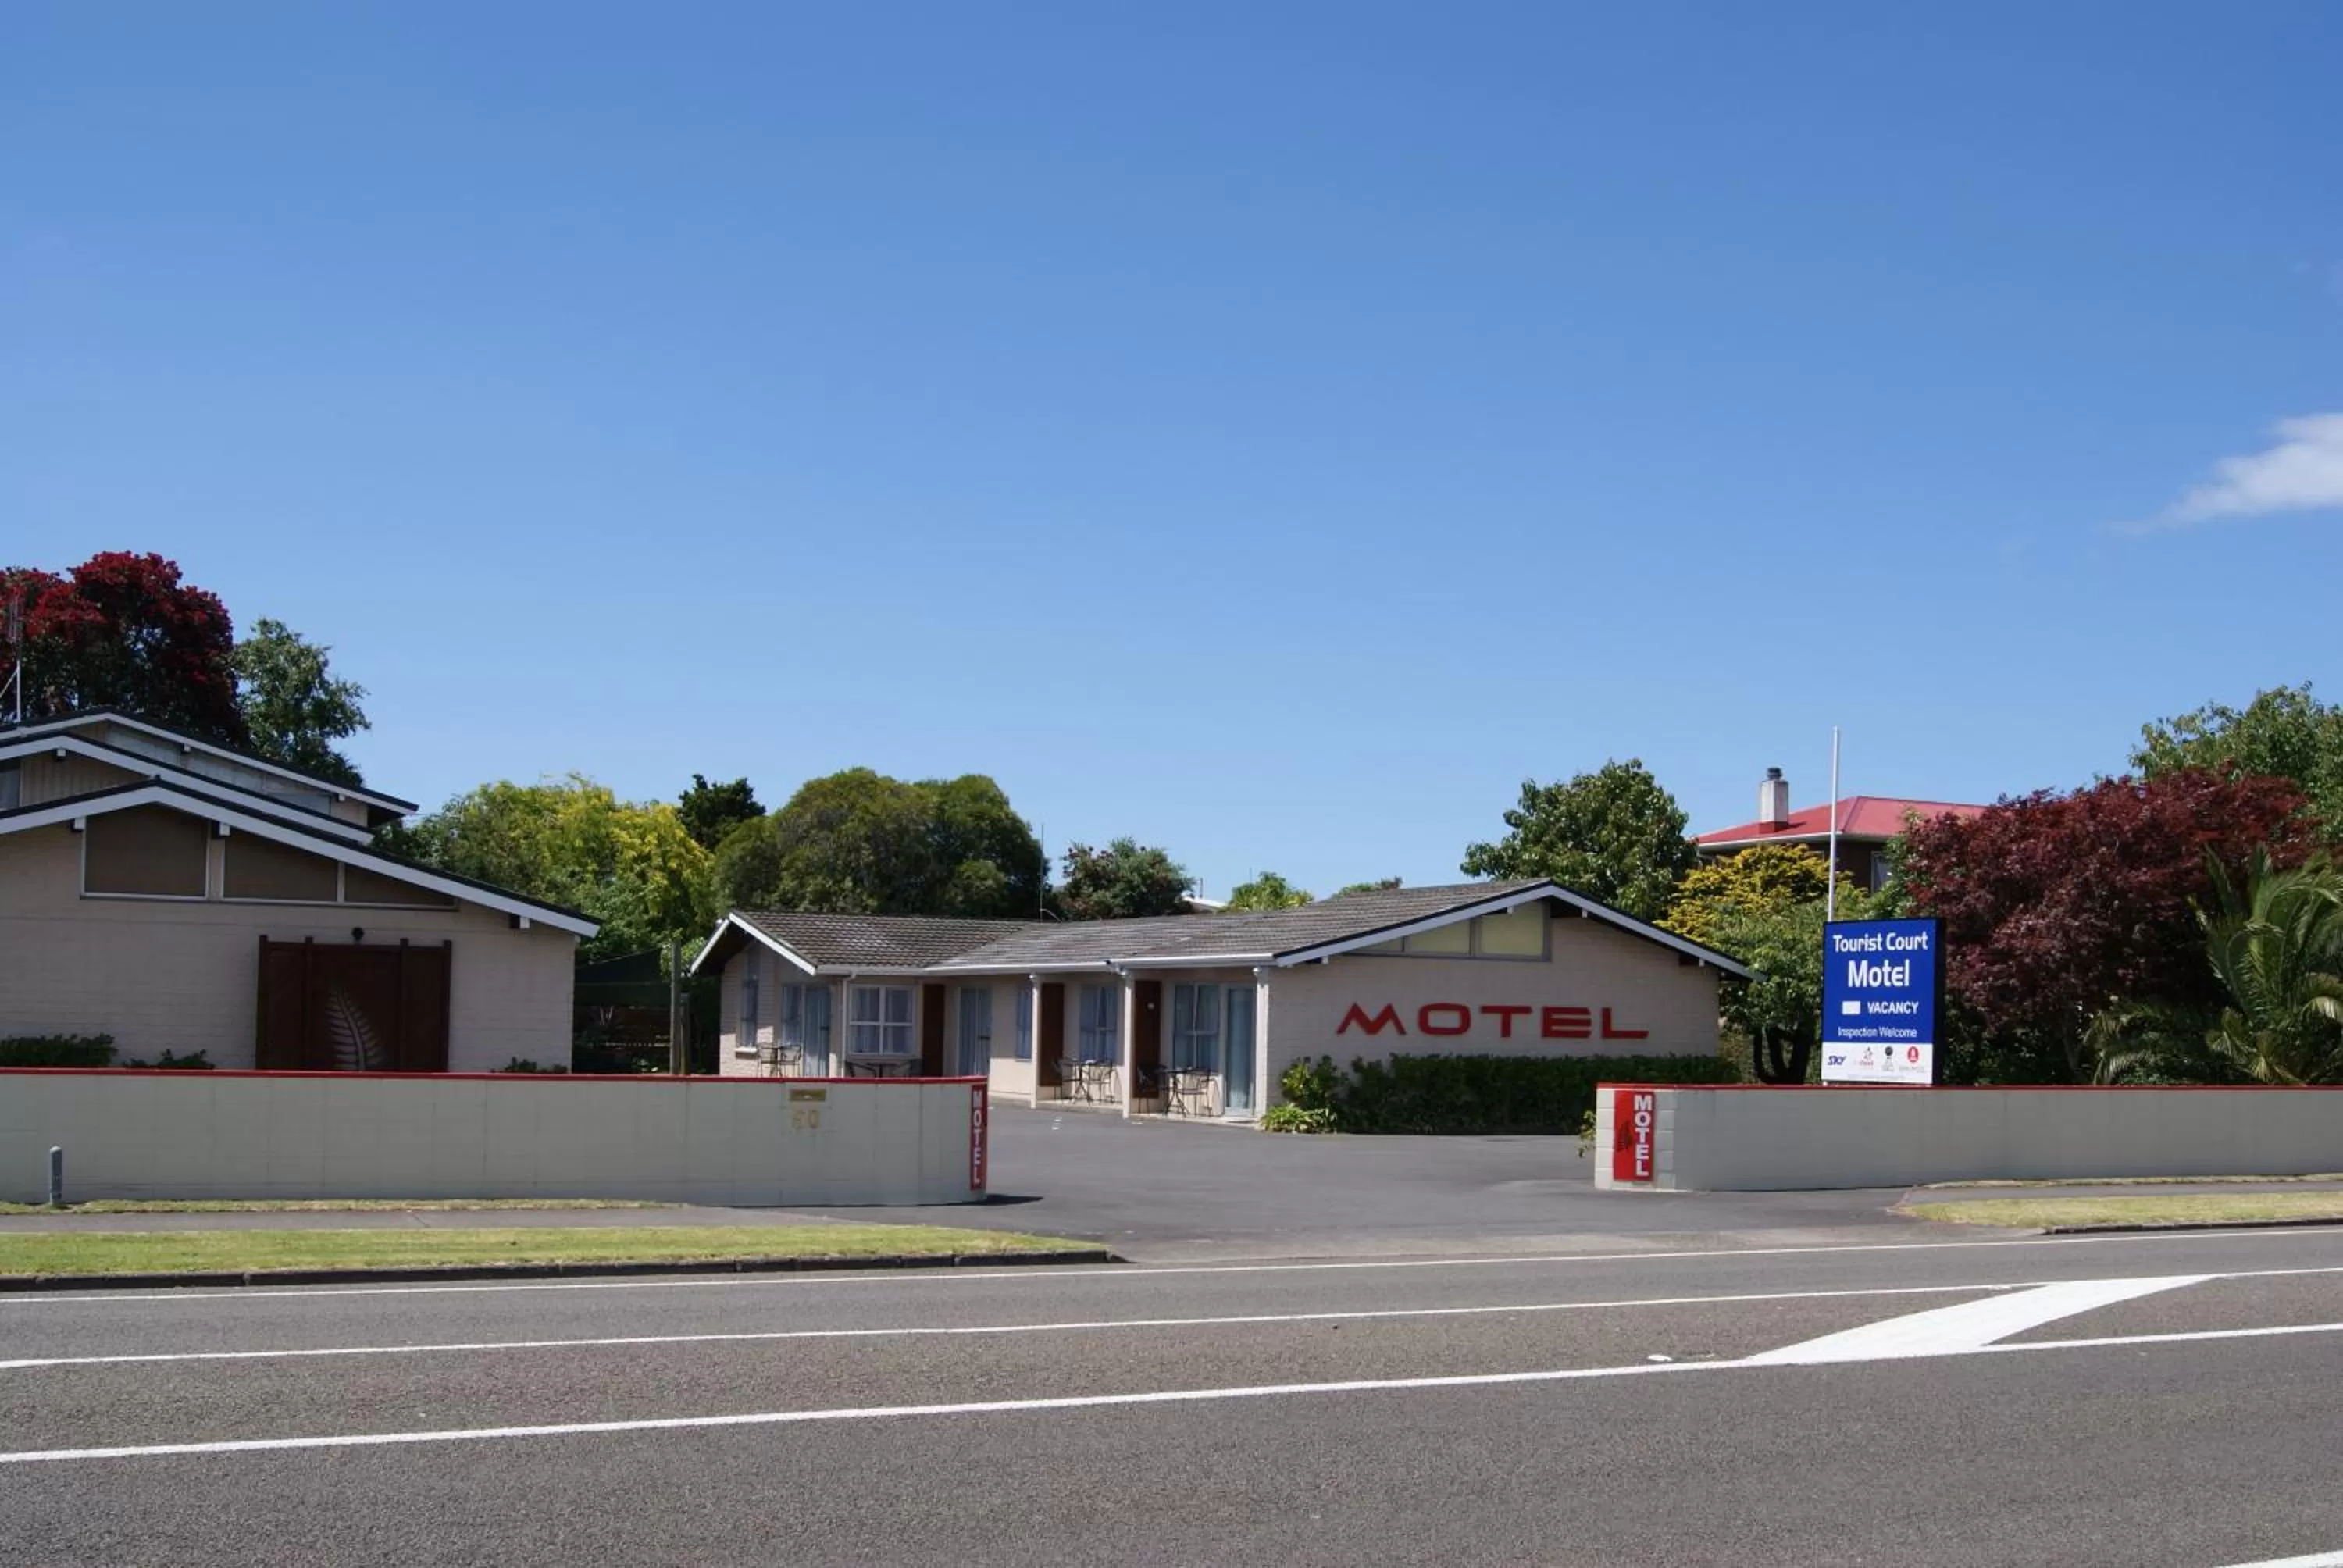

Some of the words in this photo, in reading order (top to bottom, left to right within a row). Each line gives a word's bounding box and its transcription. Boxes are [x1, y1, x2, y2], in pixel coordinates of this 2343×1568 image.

[1833, 933, 1882, 952] Tourist
[1885, 931, 1928, 950] Court
[1848, 959, 1910, 987] Motel
[1336, 1002, 1650, 1039] MOTEL
[1867, 1000, 1919, 1015] VACANCY
[1838, 1026, 1878, 1040] Inspection
[1878, 1026, 1917, 1038] Welcome
[972, 1090, 982, 1185] MOTEL
[1634, 1095, 1653, 1176] MOTEL
